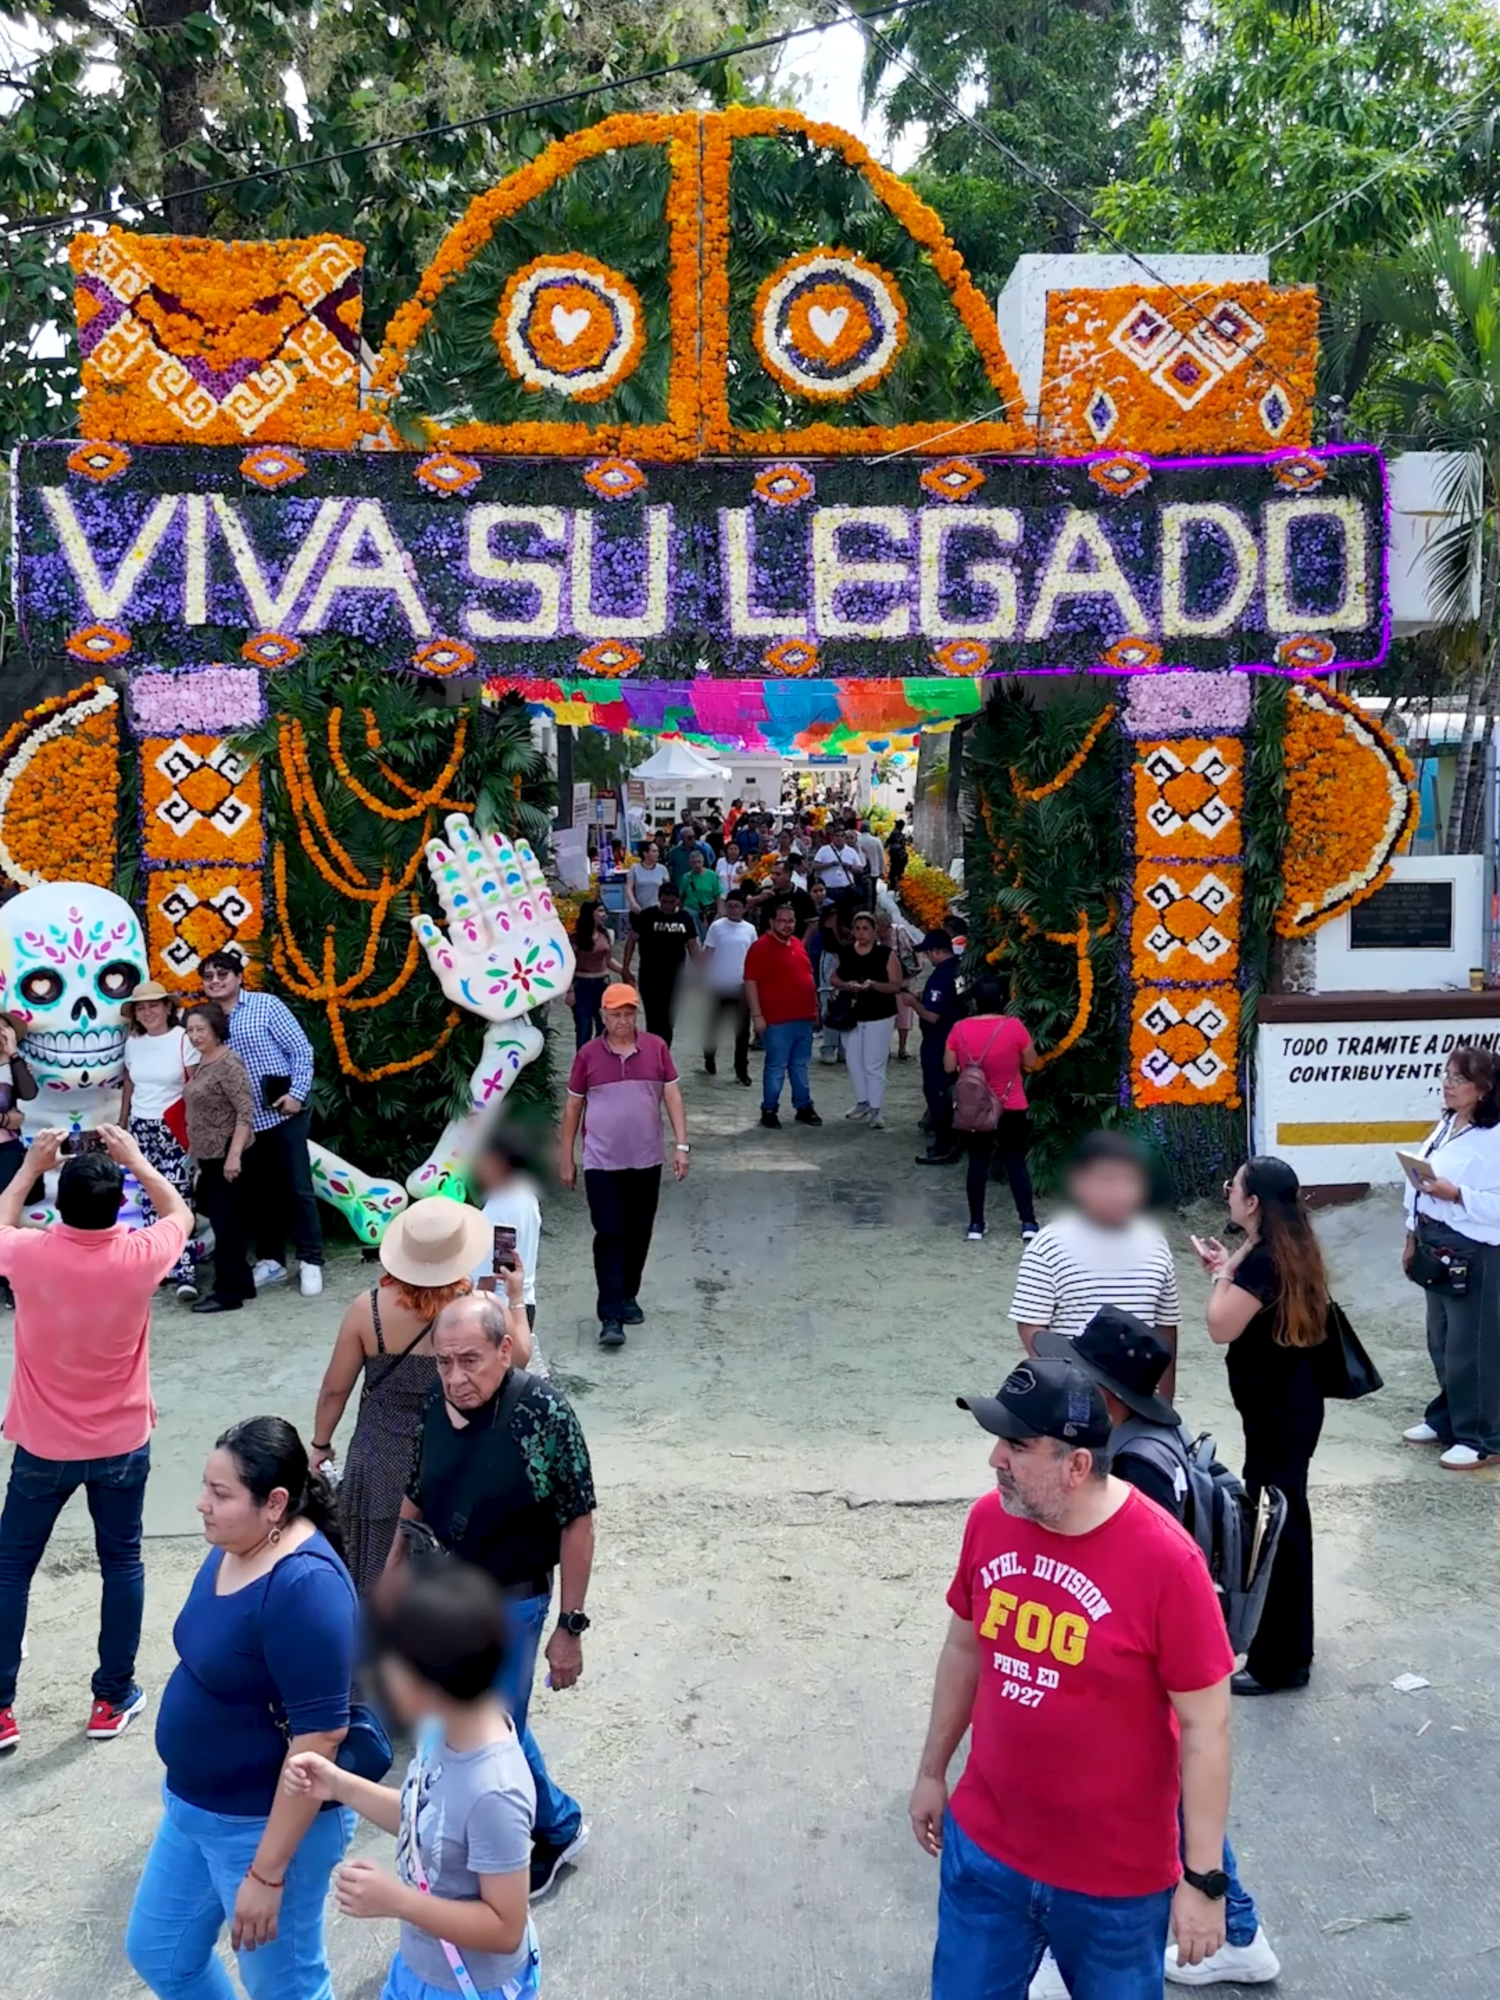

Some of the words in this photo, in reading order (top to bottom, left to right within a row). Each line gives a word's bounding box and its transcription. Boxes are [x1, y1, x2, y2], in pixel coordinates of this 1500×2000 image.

[40, 486, 432, 638] VIVA
[464, 505, 671, 638] SU
[726, 500, 1368, 638] LEGADO
[653, 921, 687, 933] NASA
[1283, 1037, 1327, 1056] TODO
[1337, 1034, 1421, 1056] TRAMITE
[1424, 1032, 1500, 1055] ADMINI
[980, 1551, 1027, 1589] ATHL.
[1032, 1554, 1112, 1622] DIVISION
[979, 1588, 1089, 1666] FOG
[993, 1652, 1032, 1682] PHYS.
[1036, 1667, 1060, 1689] ED
[1001, 1680, 1045, 1708] 1927
